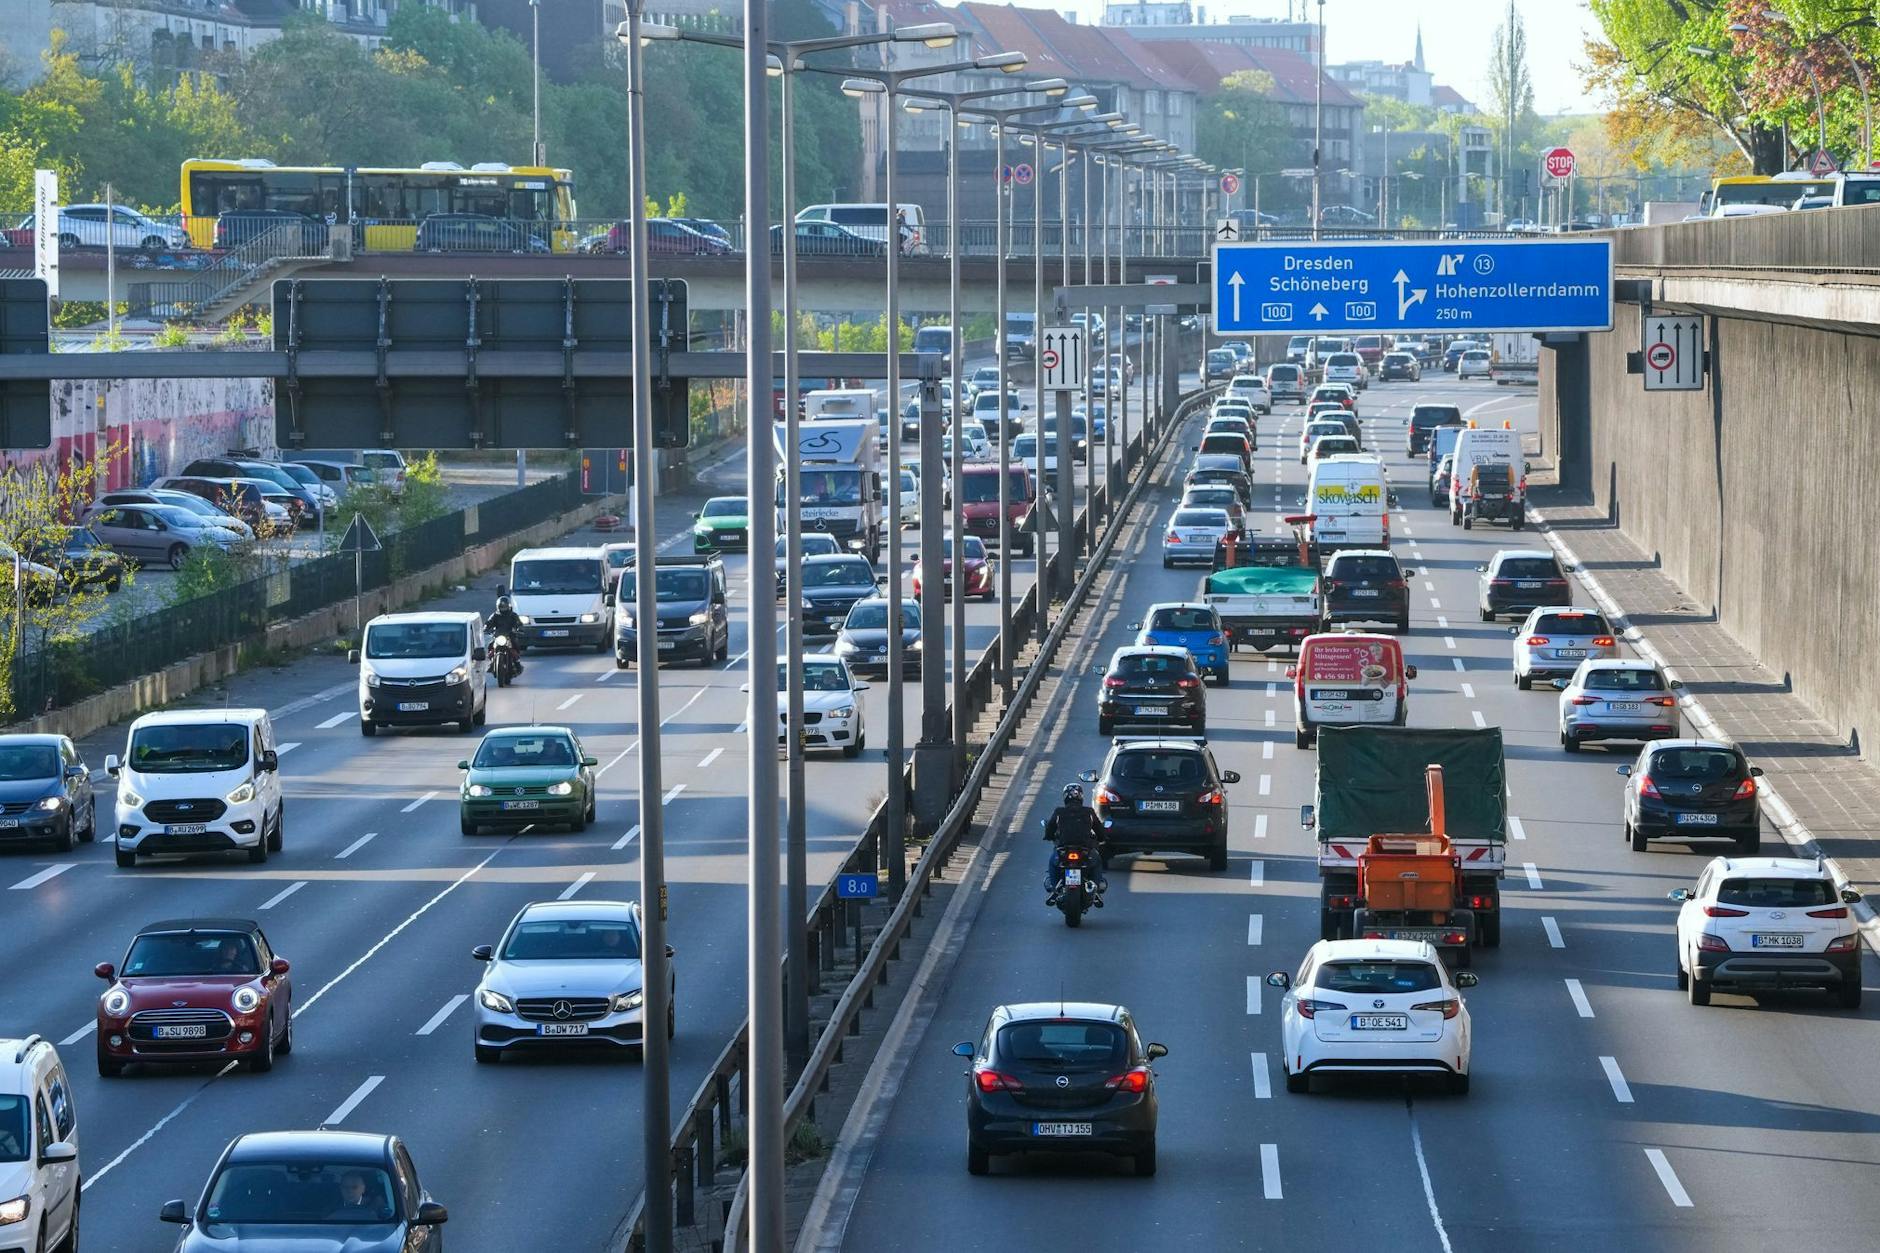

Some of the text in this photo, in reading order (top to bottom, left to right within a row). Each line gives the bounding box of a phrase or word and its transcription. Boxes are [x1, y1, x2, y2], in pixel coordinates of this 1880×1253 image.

[1548, 157, 1573, 169] STOP
[1284, 256, 1353, 270] Dresden
[1478, 258, 1491, 270] 13
[1270, 276, 1369, 294] Schöneberg
[1435, 283, 1600, 299] Hohenzollerndamm
[1267, 306, 1287, 318] 100
[1350, 305, 1371, 317] 100
[1436, 308, 1472, 320] 250 m
[1319, 489, 1378, 505] skowasch
[802, 509, 839, 518] steinecke
[848, 879, 867, 893] 8.0
[1758, 936, 1801, 945] B MK 1038
[1360, 1018, 1366, 1027] B
[1385, 1018, 1402, 1027] 541
[158, 1026, 205, 1036] B SU 9898
[545, 1025, 550, 1034] B
[569, 1024, 585, 1034] 717
[1039, 1123, 1091, 1134] OHV TJ 155
